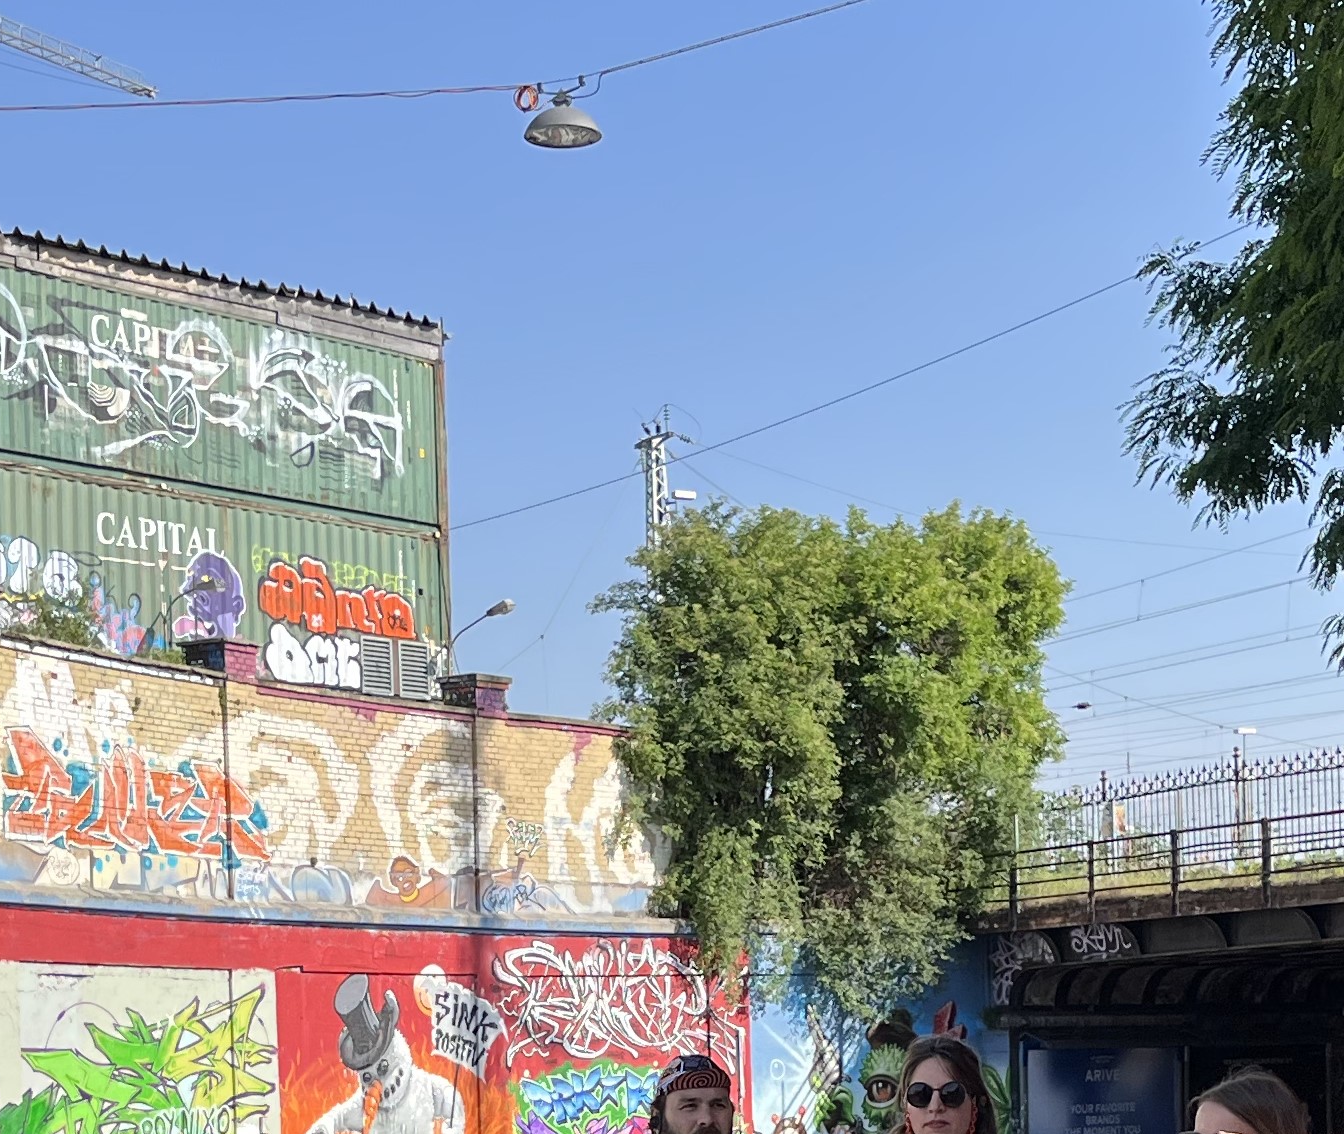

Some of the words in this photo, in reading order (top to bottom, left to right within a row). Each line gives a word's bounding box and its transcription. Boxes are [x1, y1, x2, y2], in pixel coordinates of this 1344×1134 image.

[90, 313, 217, 361] CAPIAL
[1085, 1069, 1121, 1082] ARIVE
[1095, 1102, 1136, 1112] FAVORITE
[1085, 1115, 1121, 1125] BRANDS
[1123, 1125, 1141, 1134] YOU
